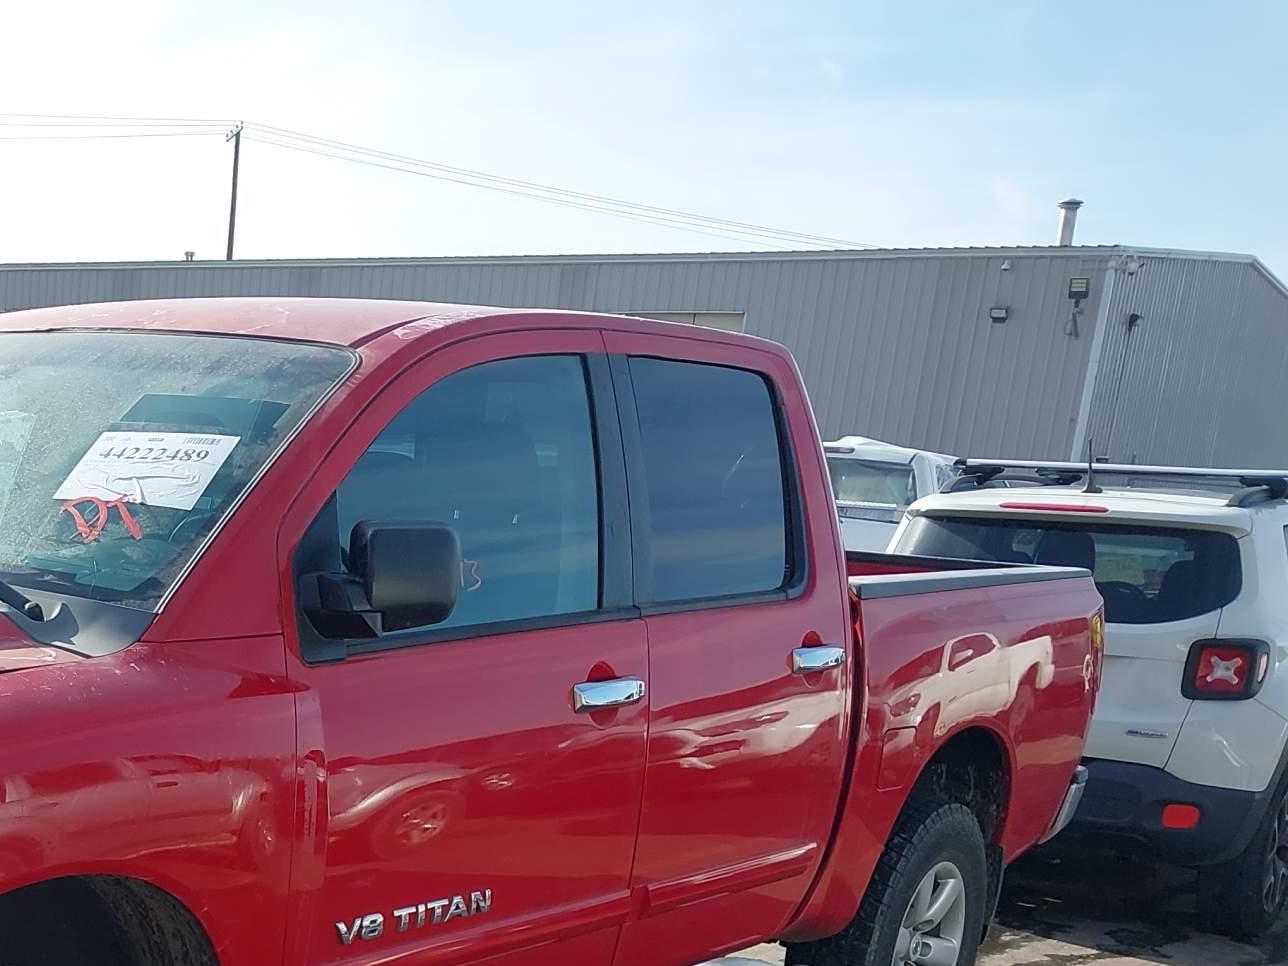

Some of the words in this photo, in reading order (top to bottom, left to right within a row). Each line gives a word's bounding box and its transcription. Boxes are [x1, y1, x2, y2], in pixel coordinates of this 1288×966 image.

[98, 446, 210, 462] 44222489
[336, 912, 384, 945] V8
[393, 888, 492, 931] TITAN
